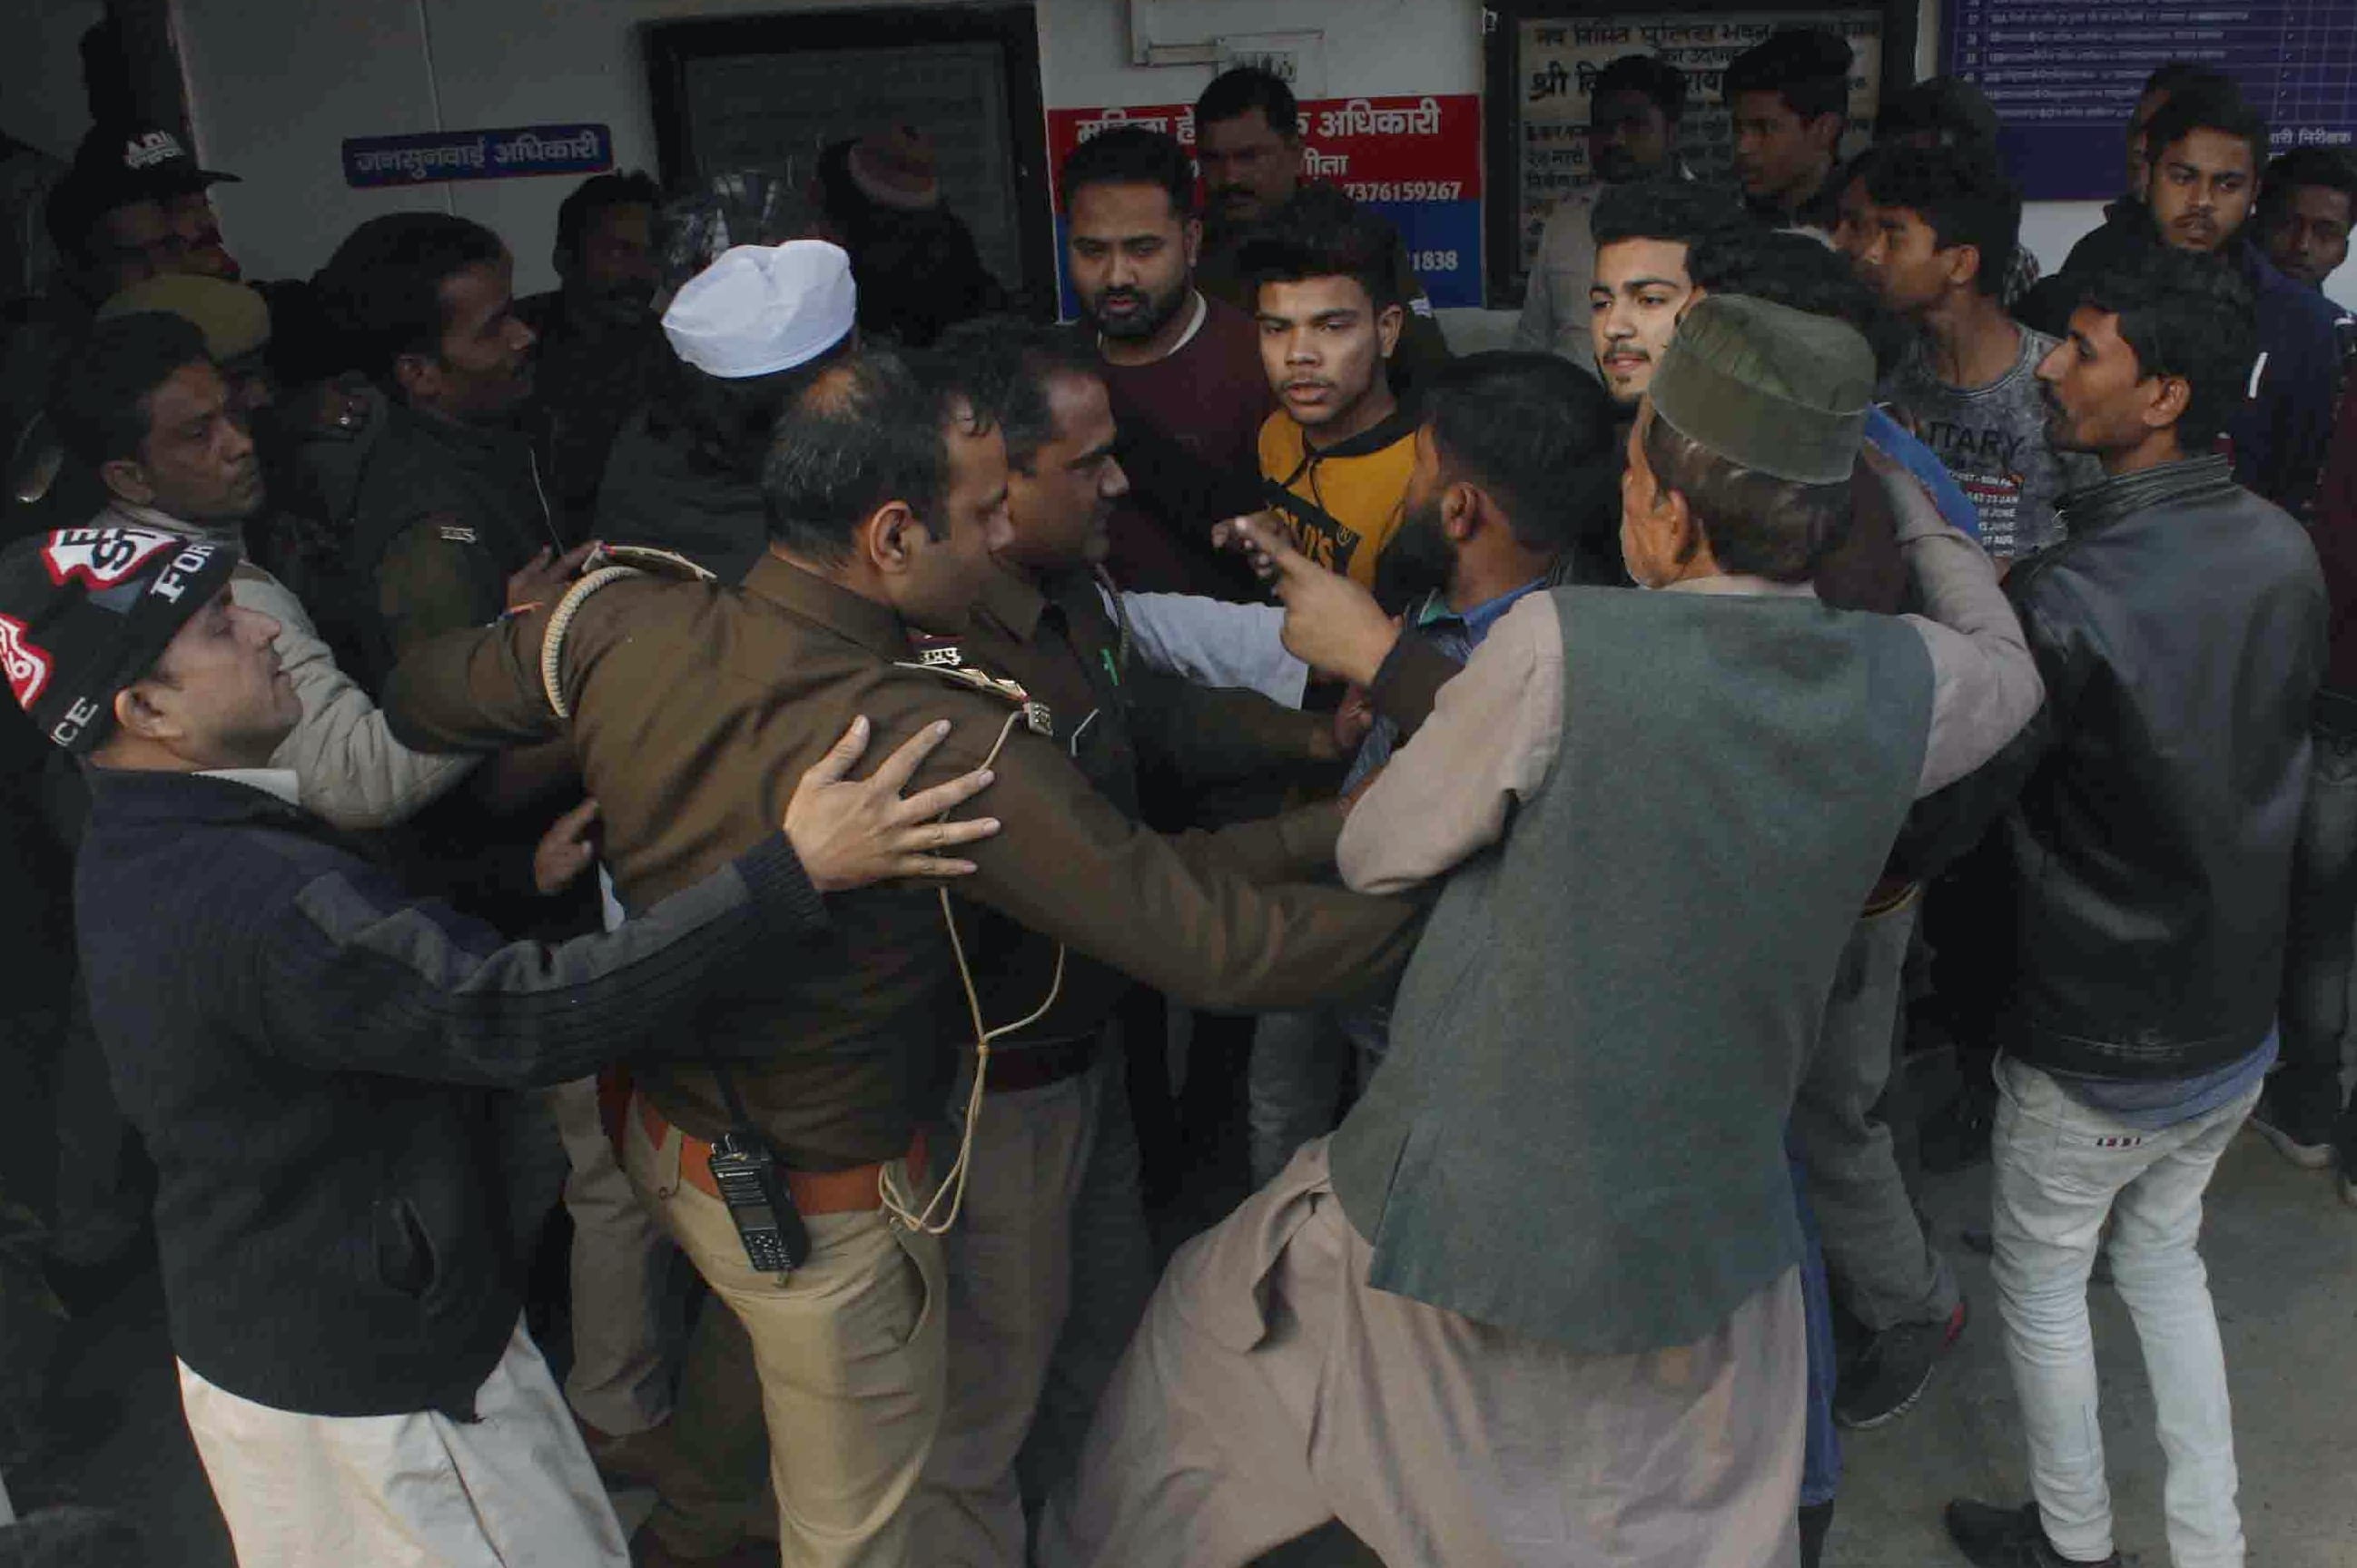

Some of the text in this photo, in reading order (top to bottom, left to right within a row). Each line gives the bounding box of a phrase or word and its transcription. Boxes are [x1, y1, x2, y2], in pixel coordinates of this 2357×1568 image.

[1317, 98, 1442, 137] अधिकारी
[353, 129, 601, 180] जनसुनवाई अधिकारी
